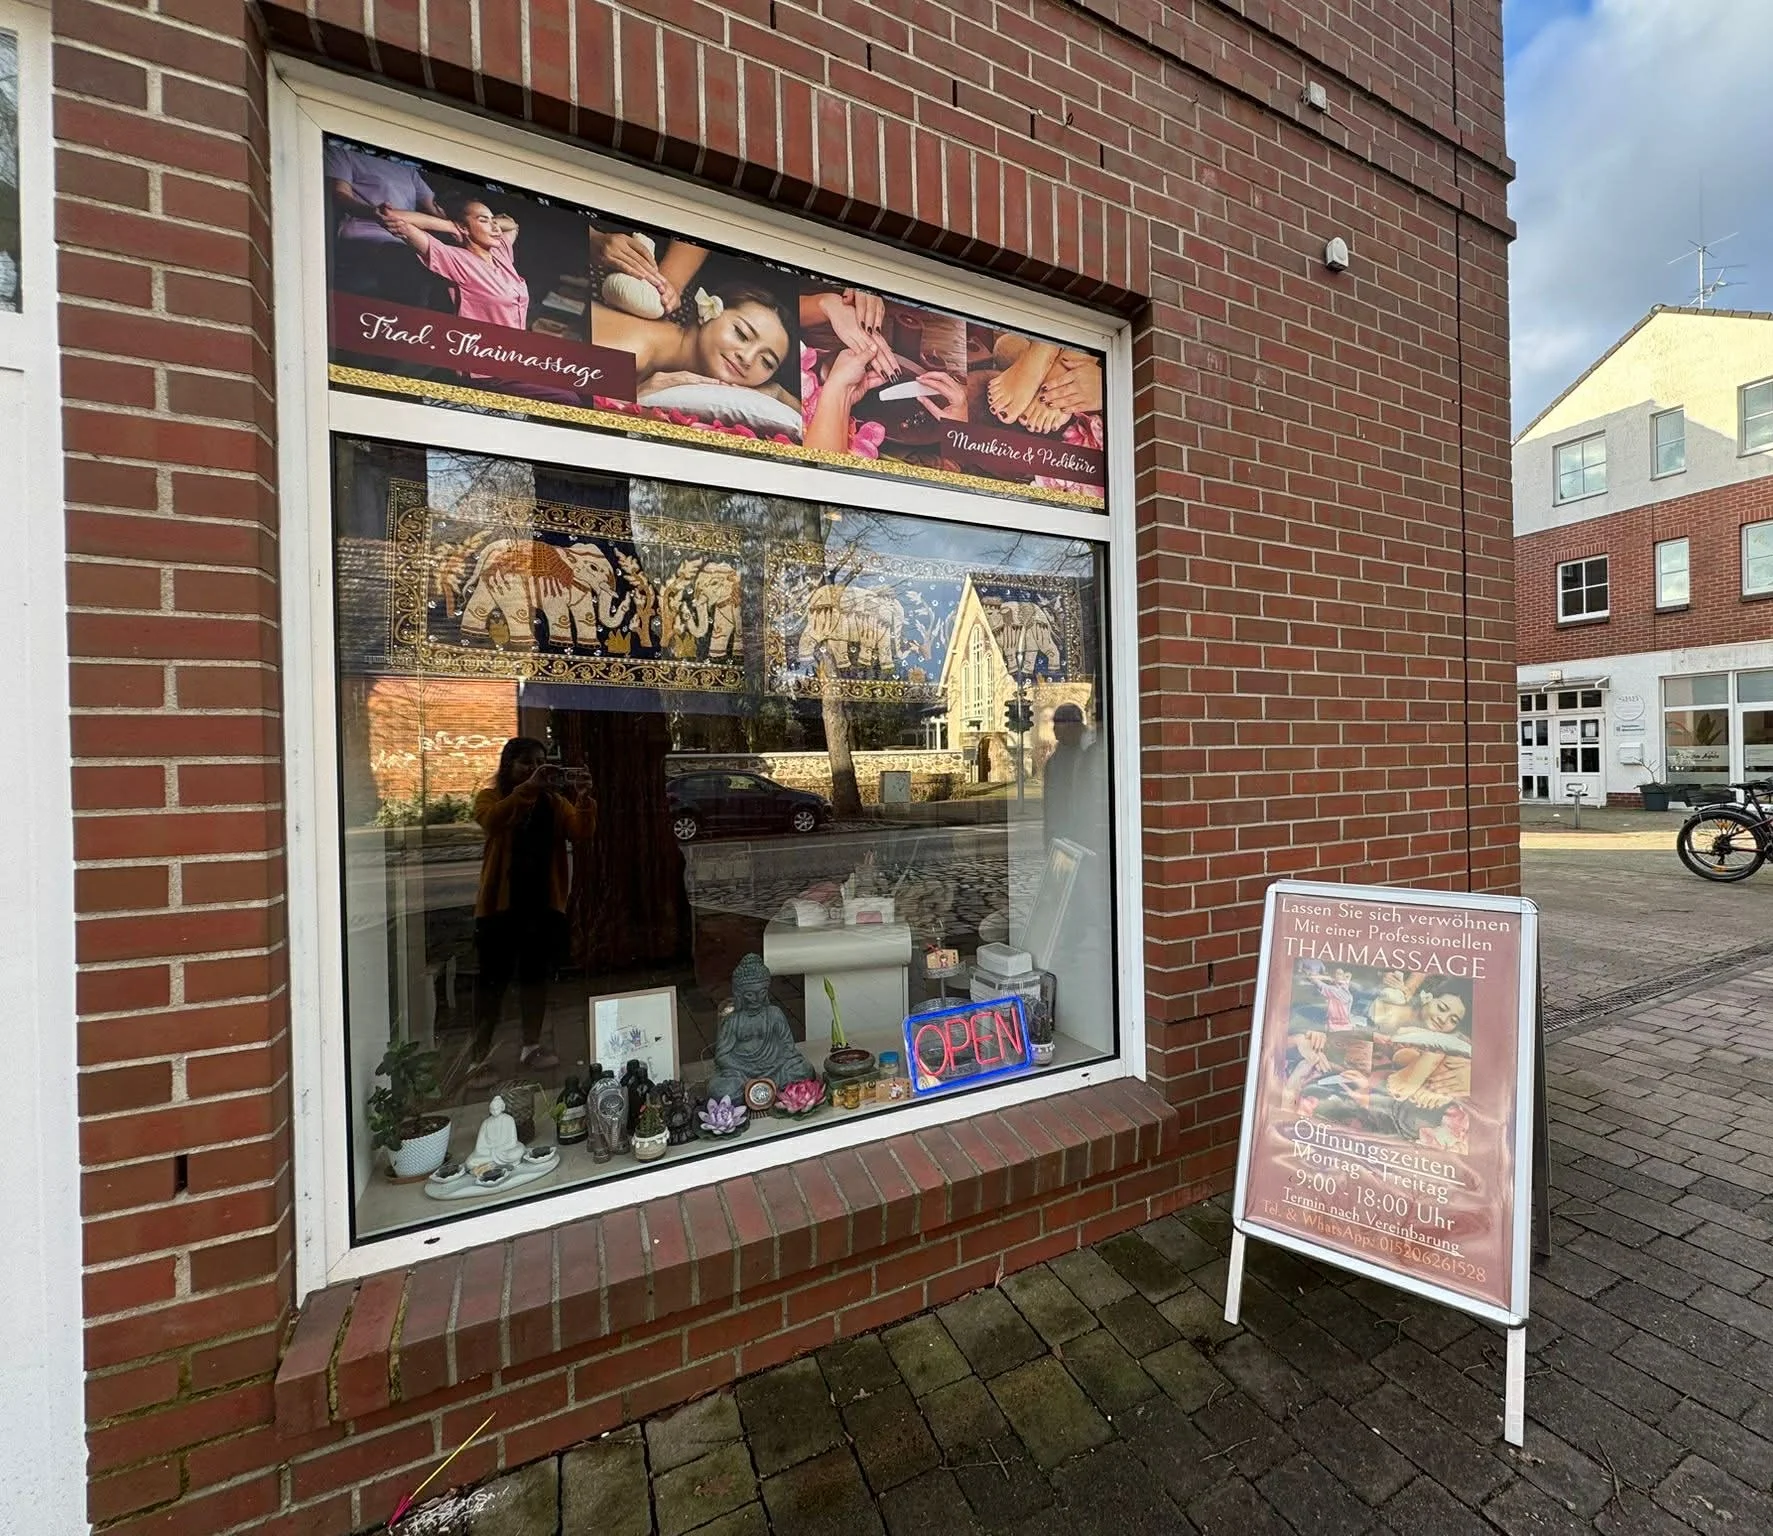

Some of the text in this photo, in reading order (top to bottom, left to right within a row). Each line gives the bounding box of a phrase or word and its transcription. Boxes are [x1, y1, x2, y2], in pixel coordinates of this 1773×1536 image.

[359, 312, 605, 388] Trad. Thaimassage
[947, 430, 1097, 475] Maniküre & Pediküre
[1282, 898, 1511, 933] Lassen Sie sich verwöhnen
[1294, 917, 1493, 952] Mit einer Professionellen
[1283, 936, 1487, 980] THAIMASSAGE
[915, 1007, 1023, 1076] OPEN
[1293, 1140, 1361, 1179] Montag
[1382, 1165, 1449, 1204] Freitag
[1294, 1117, 1457, 1179] Öffnungszeiten
[1263, 1200, 1282, 1218] Tel.
[1286, 1208, 1298, 1222] &
[1303, 1211, 1376, 1250] WhatsApp:
[1284, 1186, 1461, 1255] Termin nach Vereinbarung
[1296, 1168, 1337, 1195] 9:00
[1356, 1186, 1408, 1217] 18:00
[1417, 1203, 1456, 1232] Uhr
